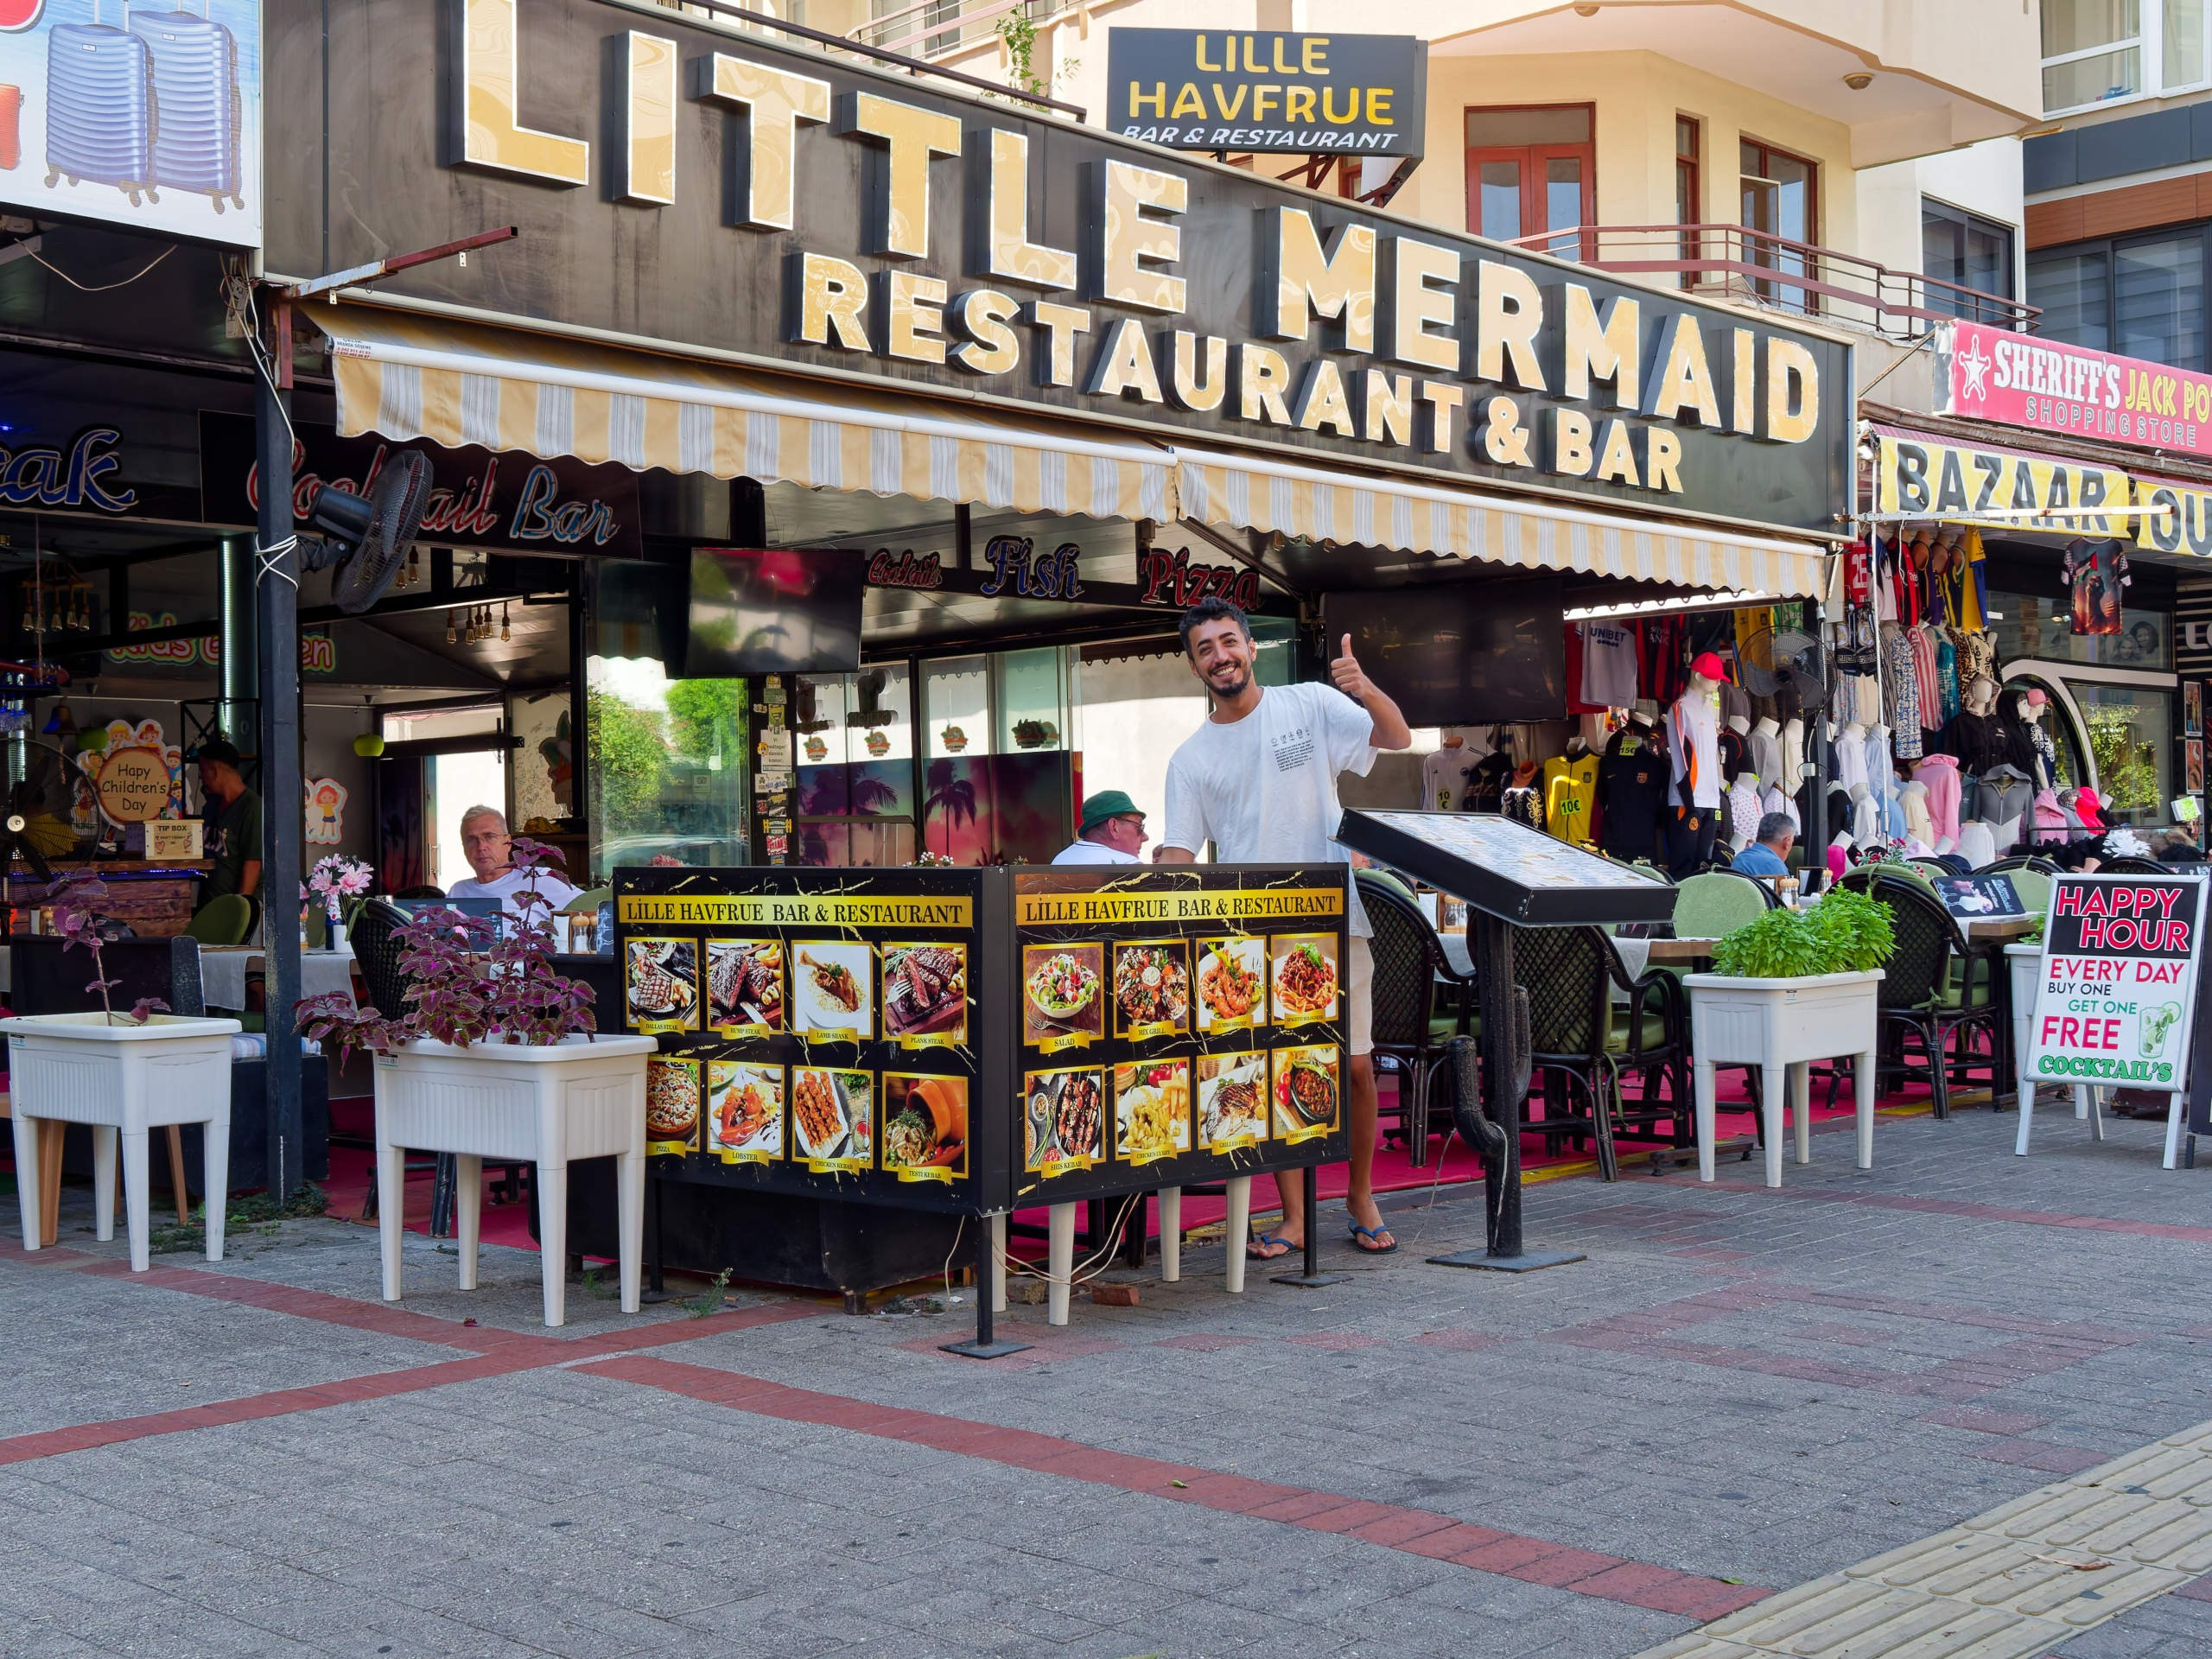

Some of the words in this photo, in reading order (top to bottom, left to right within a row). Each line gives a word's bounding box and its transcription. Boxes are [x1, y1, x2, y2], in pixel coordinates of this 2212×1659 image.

[1196, 35, 1330, 75] LILLE
[1128, 81, 1394, 124] HAVFRUE
[1123, 125, 1175, 143] BAR
[1183, 127, 1205, 143] &
[1210, 129, 1398, 149] RESTAURANT
[460, 0, 1188, 314] LITTLE
[1278, 206, 1819, 443] MERMAID
[801, 251, 1463, 454] RESTAURANT
[1479, 396, 1533, 467] &
[1554, 409, 1684, 494] BAR
[1993, 339, 2122, 410] SHERIFF'S
[2125, 368, 2177, 417] JACK
[2183, 379, 2212, 423] PO
[2026, 396, 2131, 435] SHOPPING
[2137, 416, 2196, 447] STORE
[1897, 442, 2110, 532] BAZAAR
[510, 465, 622, 545] Bar
[980, 538, 1085, 600] Fish
[1140, 549, 1265, 611] Pizza
[1590, 627, 1626, 642] UNIBET
[118, 763, 151, 781] Hapy
[102, 780, 167, 794] Children's
[1438, 791, 1451, 801] 10
[123, 797, 147, 813] Day
[1560, 799, 1580, 813] 10€
[680, 903, 764, 921] HAVFRUE
[772, 904, 810, 922] BAR
[814, 905, 829, 923] &
[835, 904, 963, 924] RESTAURANT
[1084, 899, 1169, 919] HAVFRUE
[1178, 899, 1212, 917] BAR
[1216, 898, 1229, 915] &
[1232, 895, 1336, 915] RESTAURANT
[2055, 886, 2183, 918] HAPPY
[2078, 918, 2190, 952] HOUR
[2050, 958, 2128, 982] EVERY
[2135, 962, 2185, 984] DAY
[2047, 982, 2076, 995] BUY
[2080, 982, 2113, 996] ONE
[2068, 999, 2098, 1014] GET
[2103, 1001, 2138, 1014] ONE
[1053, 1038, 1075, 1046] SALAD
[2041, 1015, 2122, 1050] FREE
[2037, 1054, 2173, 1082] COCKTAIL'S
[732, 1152, 758, 1160] LOBSTER
[1064, 1160, 1083, 1169] KEBAB
